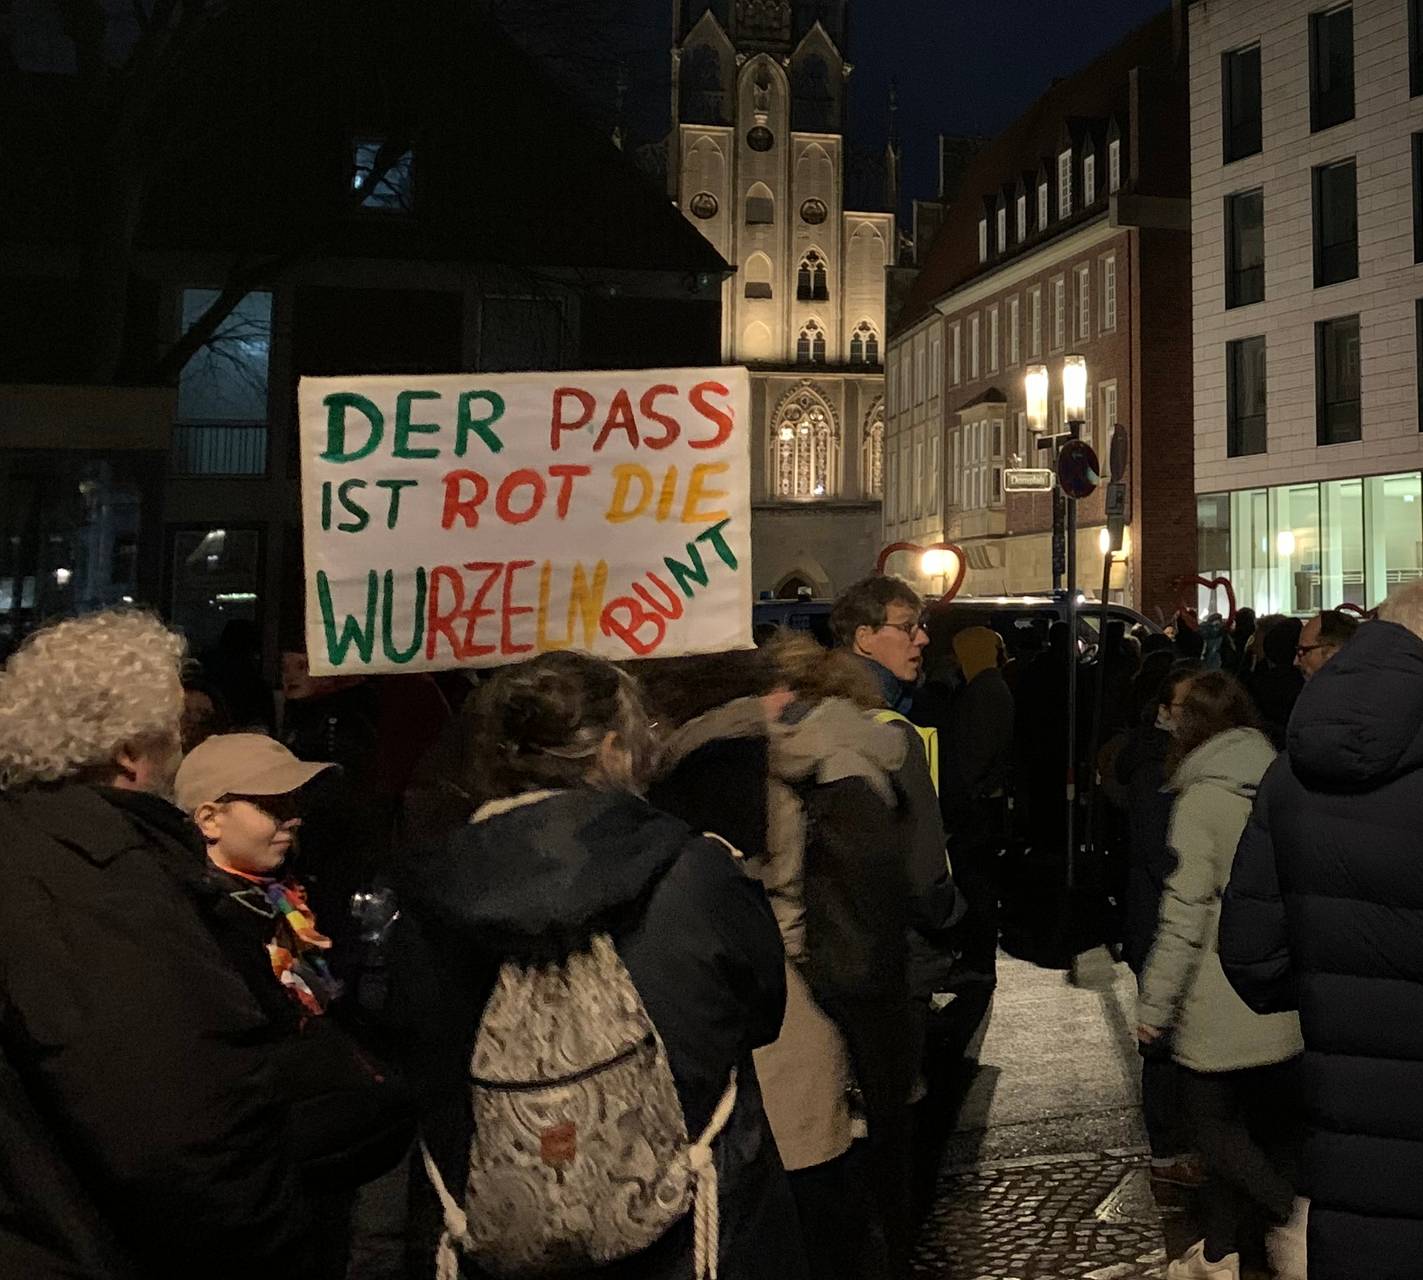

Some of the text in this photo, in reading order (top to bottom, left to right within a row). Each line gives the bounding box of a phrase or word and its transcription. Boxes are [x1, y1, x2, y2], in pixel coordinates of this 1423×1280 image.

[320, 381, 735, 463] DER PASS
[321, 462, 730, 533] IST ROT DIE
[317, 519, 738, 666] WURZELN BUNT
